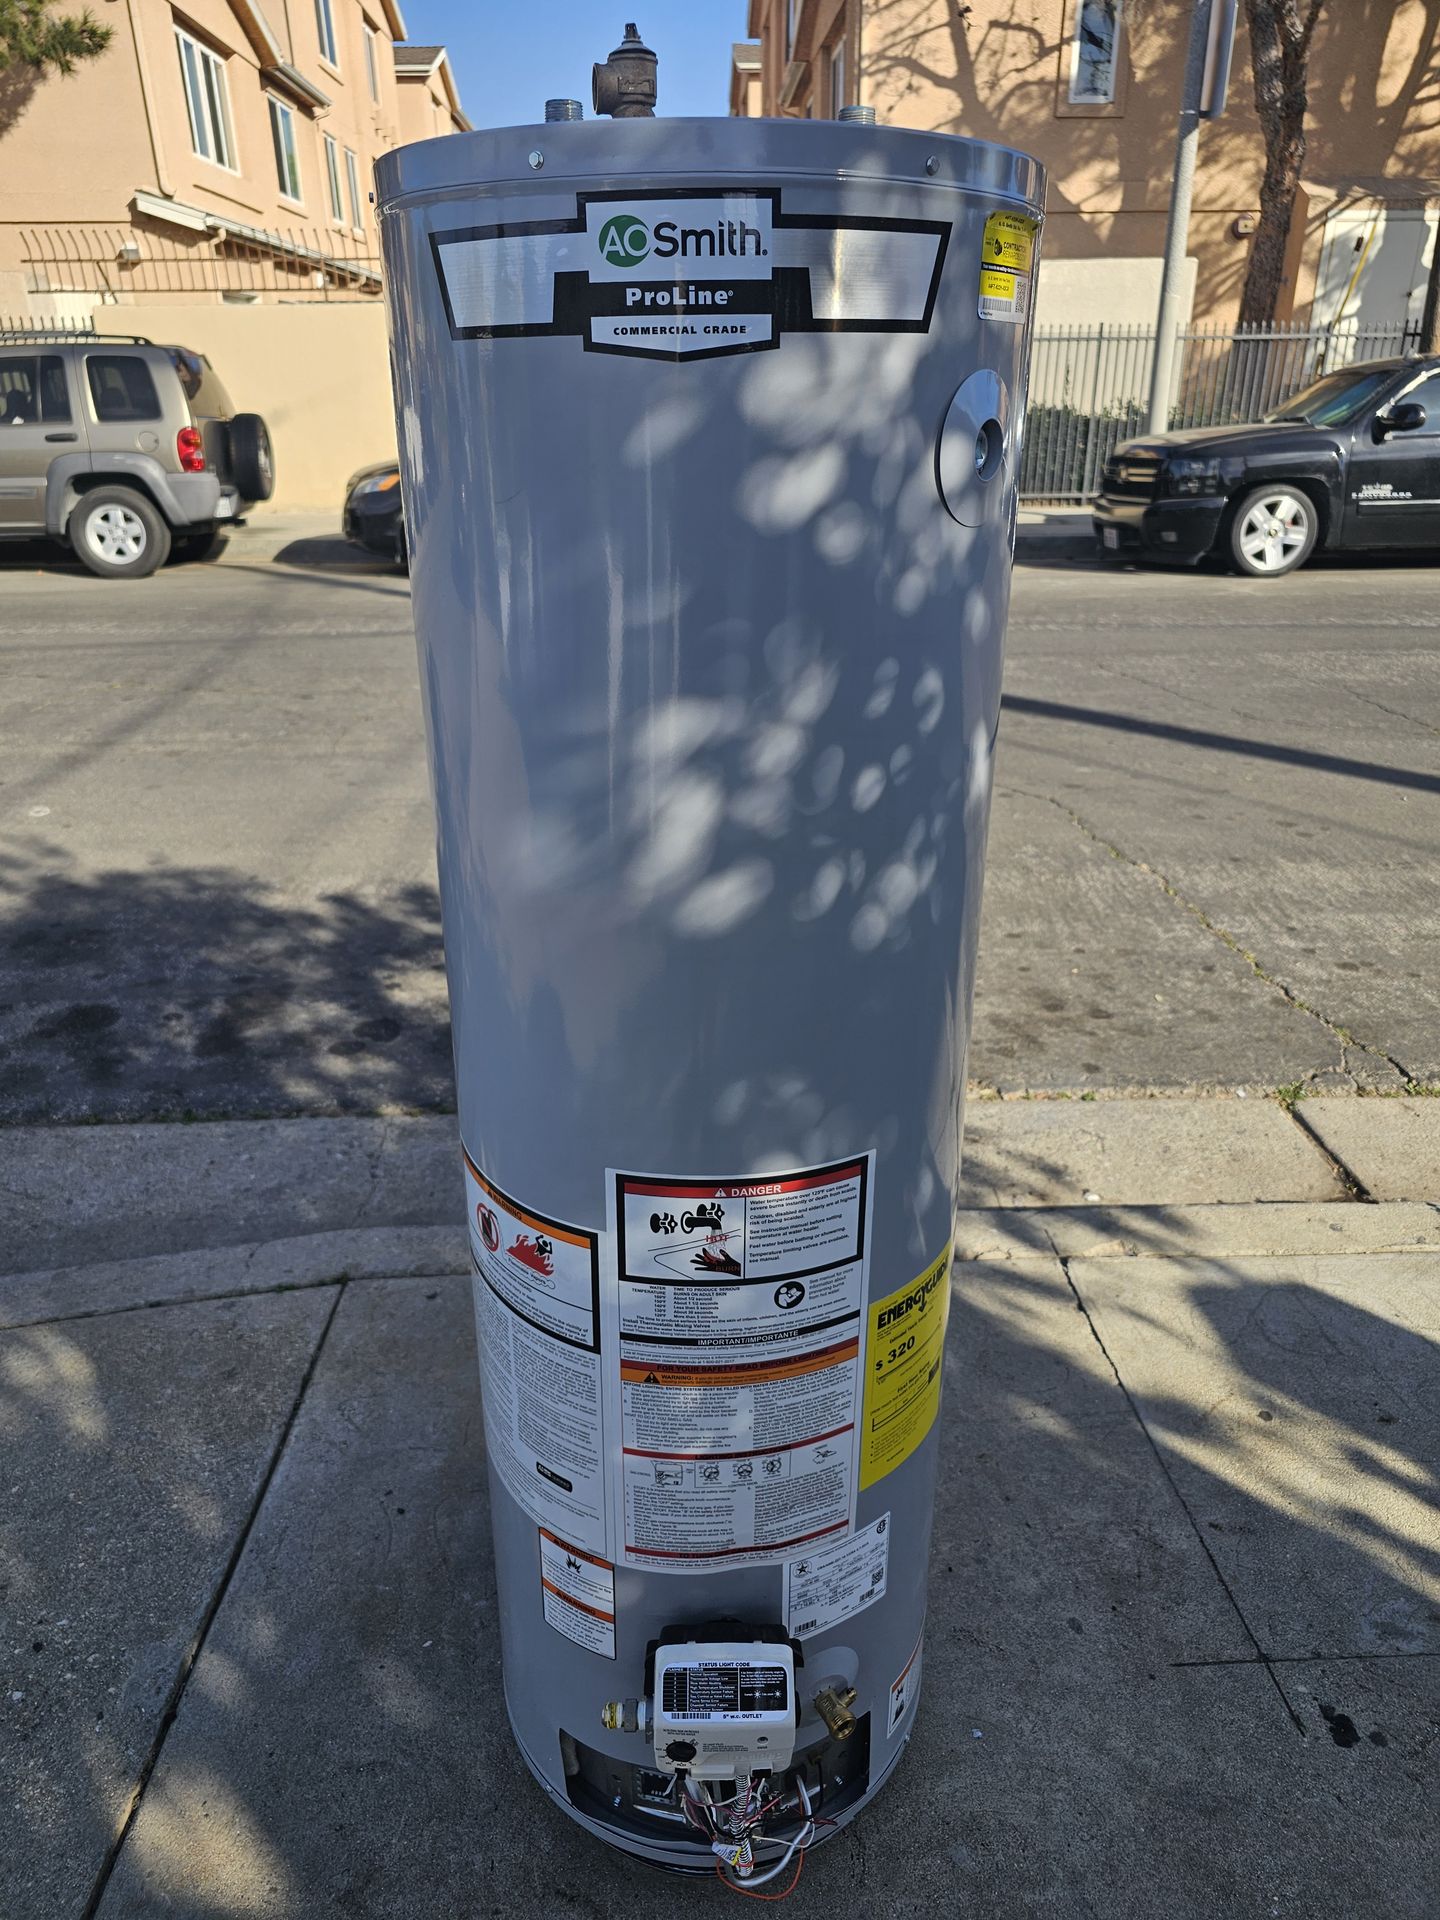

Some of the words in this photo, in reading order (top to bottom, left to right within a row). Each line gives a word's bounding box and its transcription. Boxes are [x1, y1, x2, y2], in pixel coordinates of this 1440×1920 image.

[613, 325, 698, 336] COMMERCIAL
[703, 324, 747, 335] GRADE
[731, 1184, 782, 1197] DANGER
[492, 1191, 523, 1220] WARNING
[888, 1336, 915, 1364] 320
